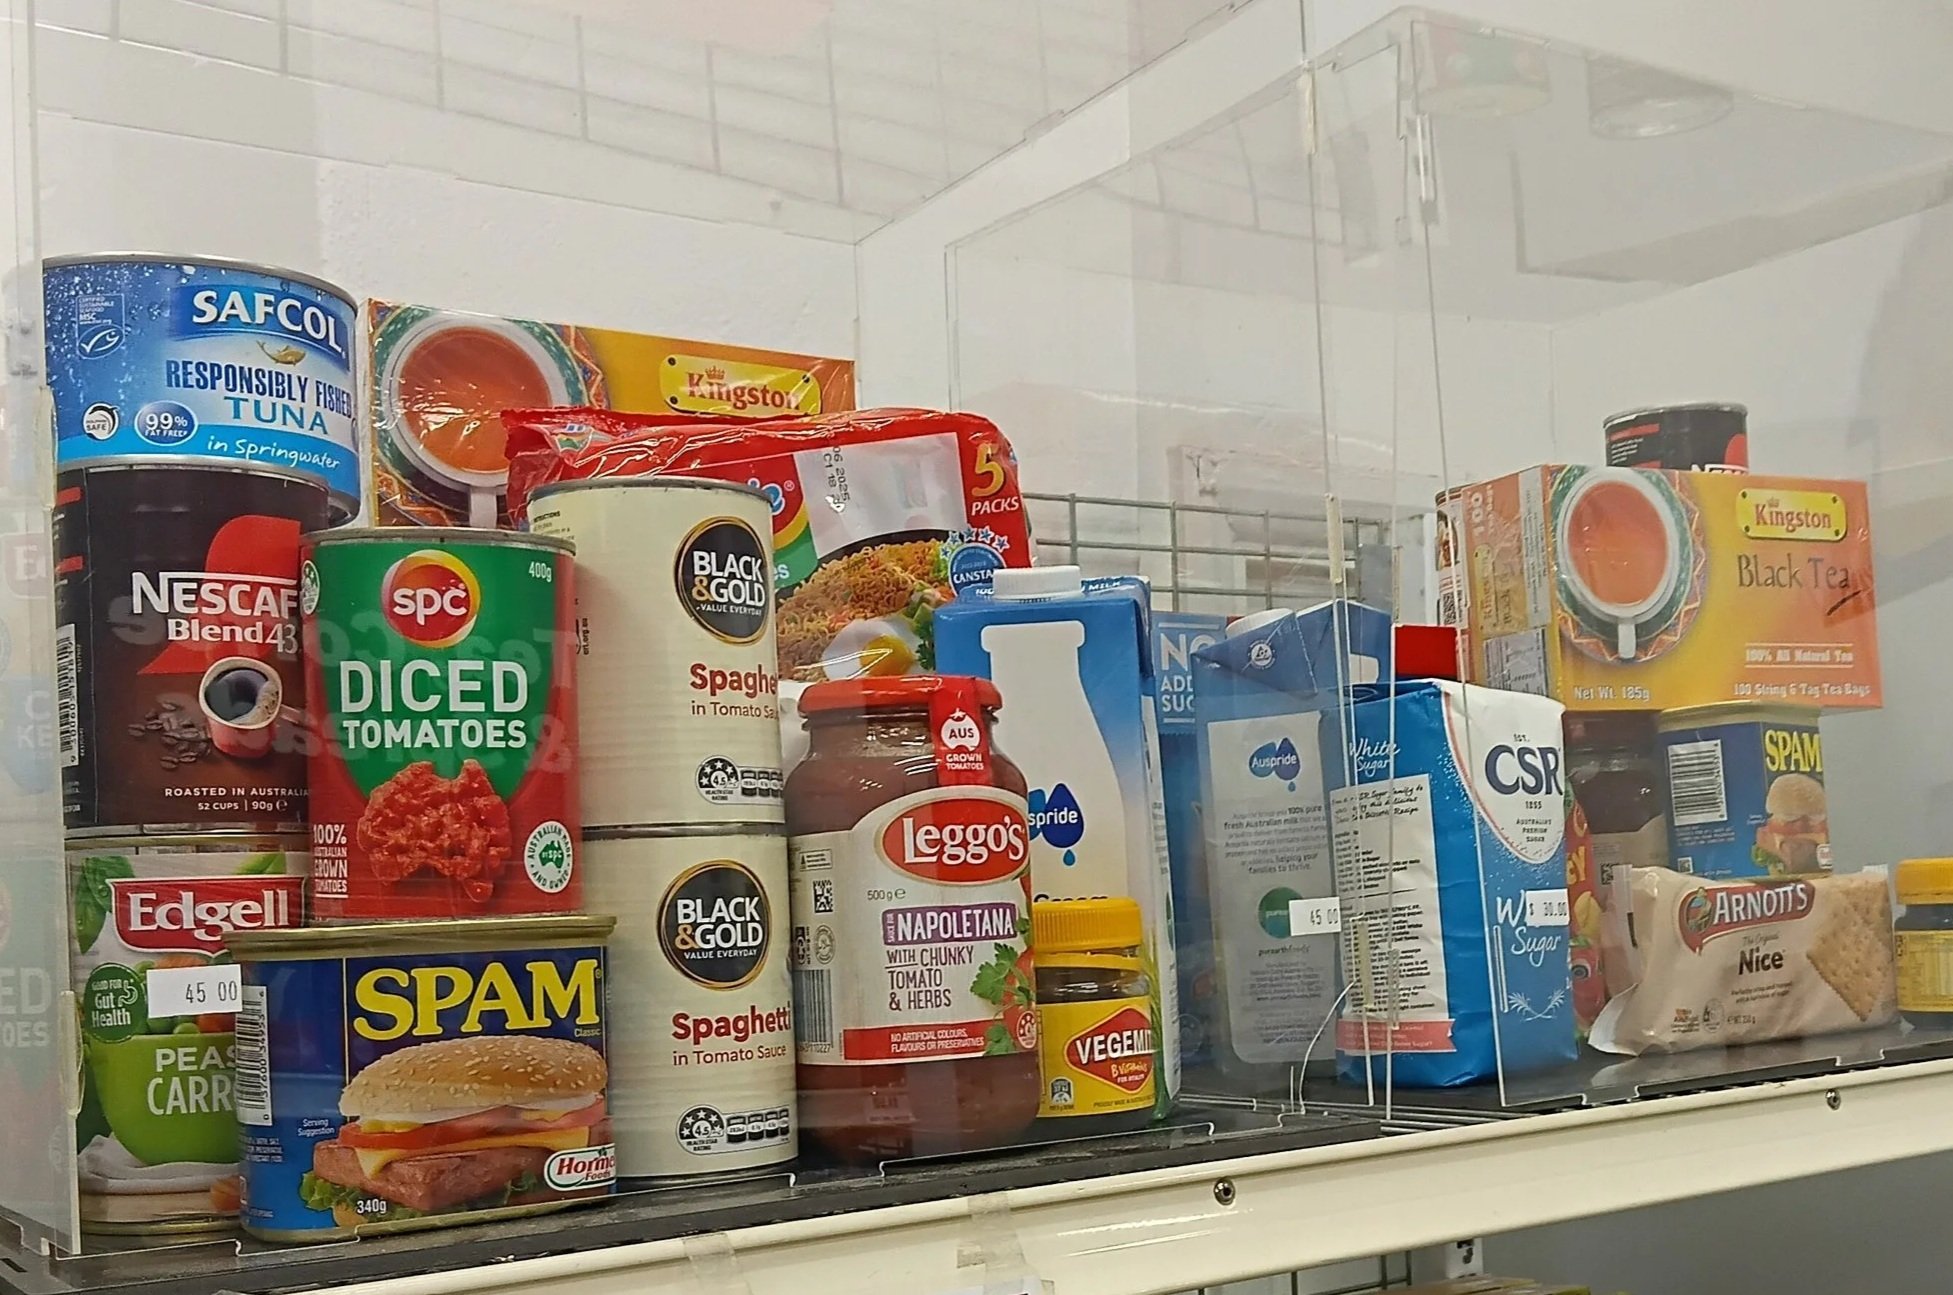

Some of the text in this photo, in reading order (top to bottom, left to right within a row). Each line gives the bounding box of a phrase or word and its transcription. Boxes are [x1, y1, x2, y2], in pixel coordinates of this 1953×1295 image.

[192, 290, 343, 353] SAFCOL
[165, 359, 353, 419] RESPONSIBLY FISHED
[686, 371, 802, 412] Kingston
[145, 412, 188, 430] 99%
[224, 395, 329, 435] TUNA
[86, 423, 107, 431] SAFE
[145, 429, 161, 437] FAT
[207, 434, 340, 470] in Springwater
[972, 443, 1005, 497] 5
[971, 496, 1020, 516] PACKS
[1755, 503, 1831, 533] Kingston
[528, 561, 553, 583] 400g
[693, 550, 764, 583] BLACK
[953, 568, 994, 584] CANSTA
[1737, 553, 1850, 590] Black Tea
[131, 571, 298, 619] NESCAF
[393, 588, 468, 626] spc
[700, 603, 762, 617] VALUE EVERYDAY
[168, 618, 298, 654] Blend 43
[339, 659, 529, 714] DICED
[1574, 686, 1594, 700] Net
[1622, 686, 1650, 702] 185g
[1755, 683, 1787, 697] String
[691, 700, 762, 718] in Tomato
[342, 718, 527, 749] TOMATOES
[948, 727, 975, 740] AUS
[946, 753, 982, 763] GROWN
[1348, 737, 1401, 757] White
[1765, 729, 1823, 773] SPAM
[946, 761, 984, 771] TOMATOES
[1251, 752, 1297, 770] Auspride
[1485, 744, 1563, 796] CSR
[165, 787, 310, 798] ROASTED IN AUSTRALIA
[197, 800, 274, 812] 52 CUPS 90g
[1028, 806, 1079, 829] spride
[313, 824, 348, 845] 100%
[902, 815, 1025, 866] Leggo's
[314, 859, 348, 878] GROWN
[867, 890, 886, 901] 500
[1713, 882, 1808, 925] ARNOTT'S
[127, 889, 290, 941] Edgell
[675, 896, 761, 924] BLACK
[1310, 908, 1322, 926] 45
[897, 907, 1014, 941] NAPOLETANA
[683, 949, 758, 960] VALUE EVERYDAY
[887, 945, 974, 967] WITH CHUNKY
[1511, 926, 1562, 967] Sugar
[1738, 946, 1784, 976] Nice
[888, 968, 943, 990] TOMATO
[95, 992, 116, 1009] Gut
[185, 980, 238, 1004] 45 00
[352, 959, 600, 1041] SPAM
[889, 989, 952, 1012] & HERBS
[91, 1008, 131, 1028] Health
[671, 1001, 791, 1045] Spaghetti
[890, 1033, 902, 1042] NO
[902, 1030, 937, 1041] ARTIFICIAL
[890, 1036, 985, 1053] FLAVOURS OR PRESERVATIVES
[672, 1050, 689, 1067] in
[693, 1049, 755, 1067] Tomato
[757, 1045, 787, 1060] Sauce
[147, 1074, 237, 1116] CARR
[297, 1127, 335, 1138] Suggestion
[302, 1118, 329, 1128] Serving
[556, 1155, 616, 1175] Horme
[357, 1199, 387, 1215] 340g
